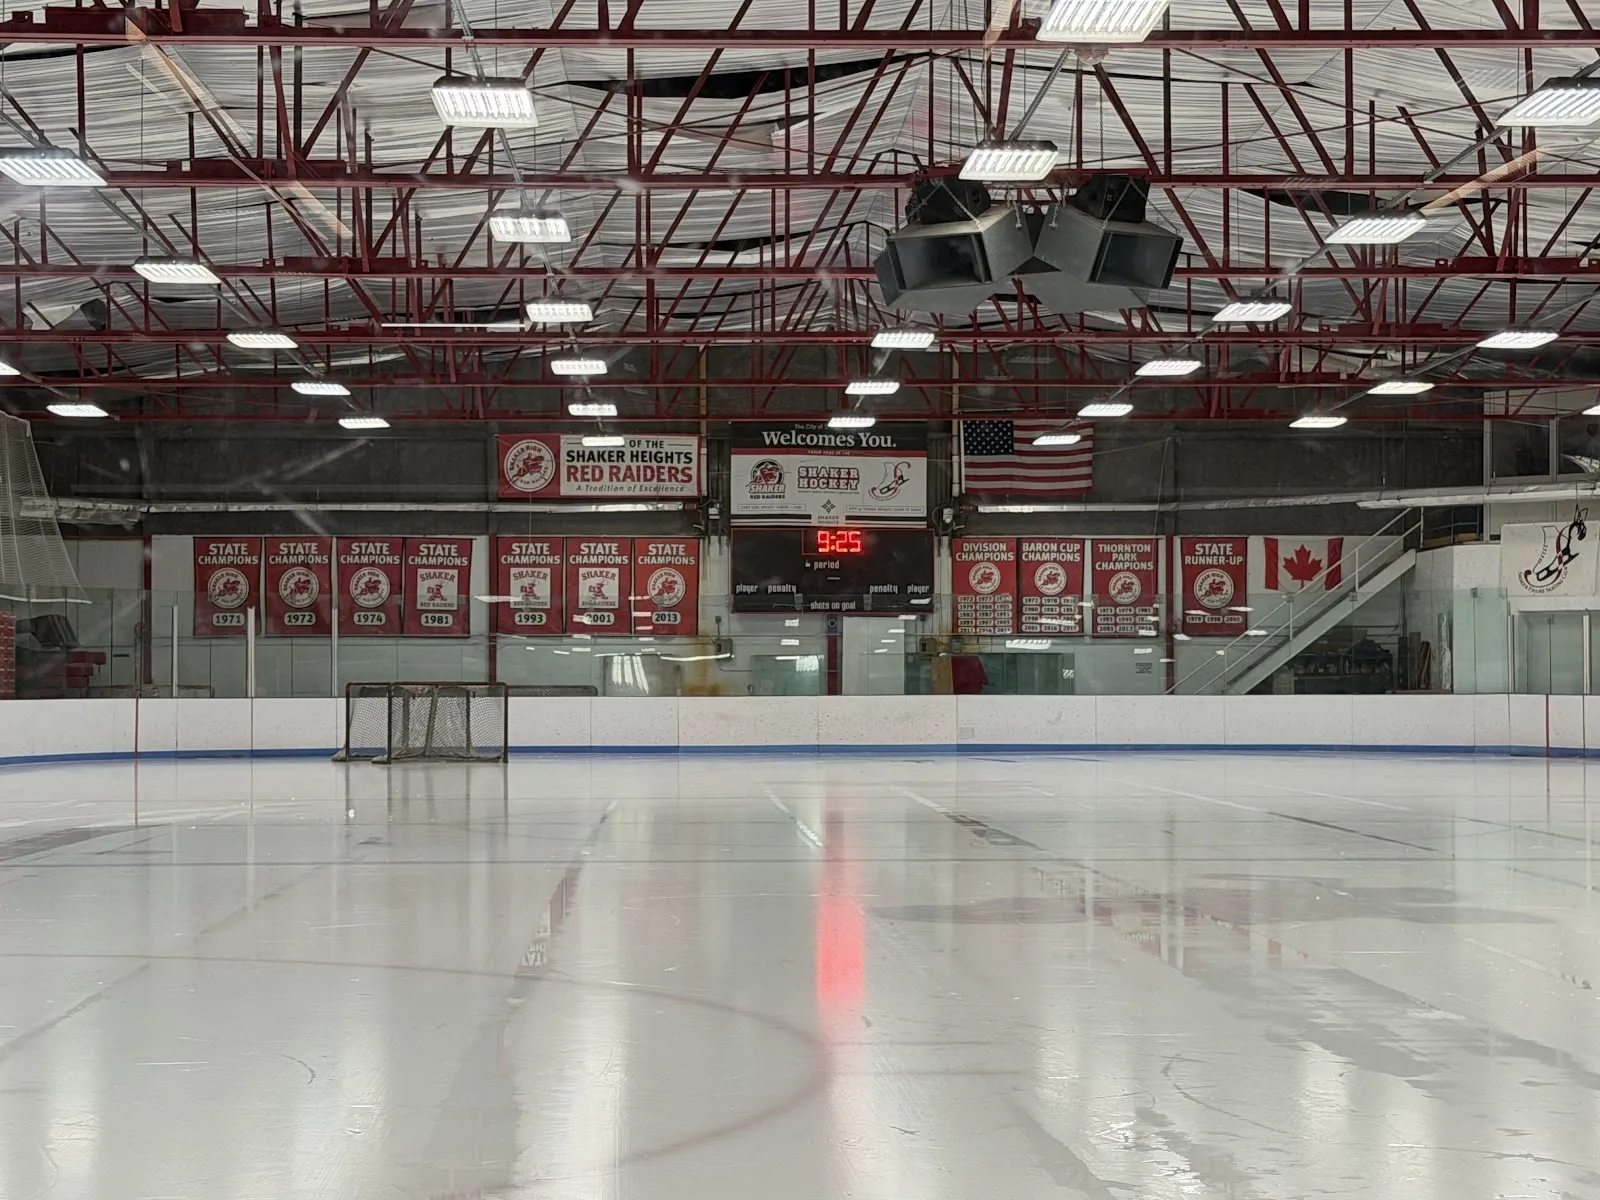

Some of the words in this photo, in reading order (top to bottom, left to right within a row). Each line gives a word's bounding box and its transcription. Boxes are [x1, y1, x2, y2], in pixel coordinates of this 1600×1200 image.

[629, 439, 643, 448] OF
[645, 440, 665, 448] THE
[762, 430, 855, 447] Welcomes
[858, 432, 897, 448] You.
[509, 447, 525, 471] SHAKER
[566, 450, 625, 463] SHAKER
[630, 450, 693, 464] HEIGHTS
[566, 465, 604, 482] RED
[608, 465, 693, 484] RAIDERS
[798, 466, 860, 478] SHAKER
[585, 484, 624, 492] Tradition
[627, 484, 638, 492] of
[638, 484, 685, 492] Excellence
[749, 483, 786, 494] SHAKER
[798, 478, 858, 490] HOCKEY
[817, 530, 862, 553] 9:25
[208, 543, 248, 555] STATE
[279, 542, 318, 554] STATE
[350, 542, 390, 554] STATE
[419, 544, 458, 556] STATE
[511, 542, 550, 554] STATE
[580, 542, 619, 554] STATE
[648, 544, 686, 556] STATE
[962, 542, 1007, 552] DIVISION
[1022, 542, 1058, 552] BARON
[1060, 543, 1080, 553] CUP
[1098, 544, 1151, 553] THORNTON
[1194, 543, 1234, 556] STATE
[198, 556, 259, 565] CHAMPIONS
[268, 555, 329, 564] CHAMPIONS
[340, 555, 401, 564] CHAMPIONS
[408, 556, 468, 566] CHAMPIONS
[500, 555, 561, 565] CHAMPIONS
[569, 555, 629, 565] CHAMPIONS
[638, 556, 696, 566] CHAMPIONS
[956, 552, 1014, 562] CHAMPIONS
[1022, 552, 1080, 562] CHAMPIONS
[1112, 552, 1138, 562] PARK
[1184, 556, 1244, 566] RUNNER-UP
[813, 560, 840, 570] period
[1096, 562, 1154, 571] CHAMPIONS
[420, 572, 456, 582] SHAKER
[512, 570, 548, 581] SHAKER
[581, 570, 616, 581] SHAKER
[736, 584, 758, 594] player
[768, 584, 796, 594] penalty
[870, 584, 898, 594] penalty
[907, 584, 930, 594] player
[810, 601, 830, 610] shots
[832, 602, 840, 610] on
[842, 601, 856, 612] goal
[215, 614, 241, 624] 1971
[286, 614, 314, 624] 1972
[356, 614, 383, 624] 1974
[424, 615, 450, 624] 1981
[516, 614, 544, 624] 1993
[654, 613, 678, 622] 2013
